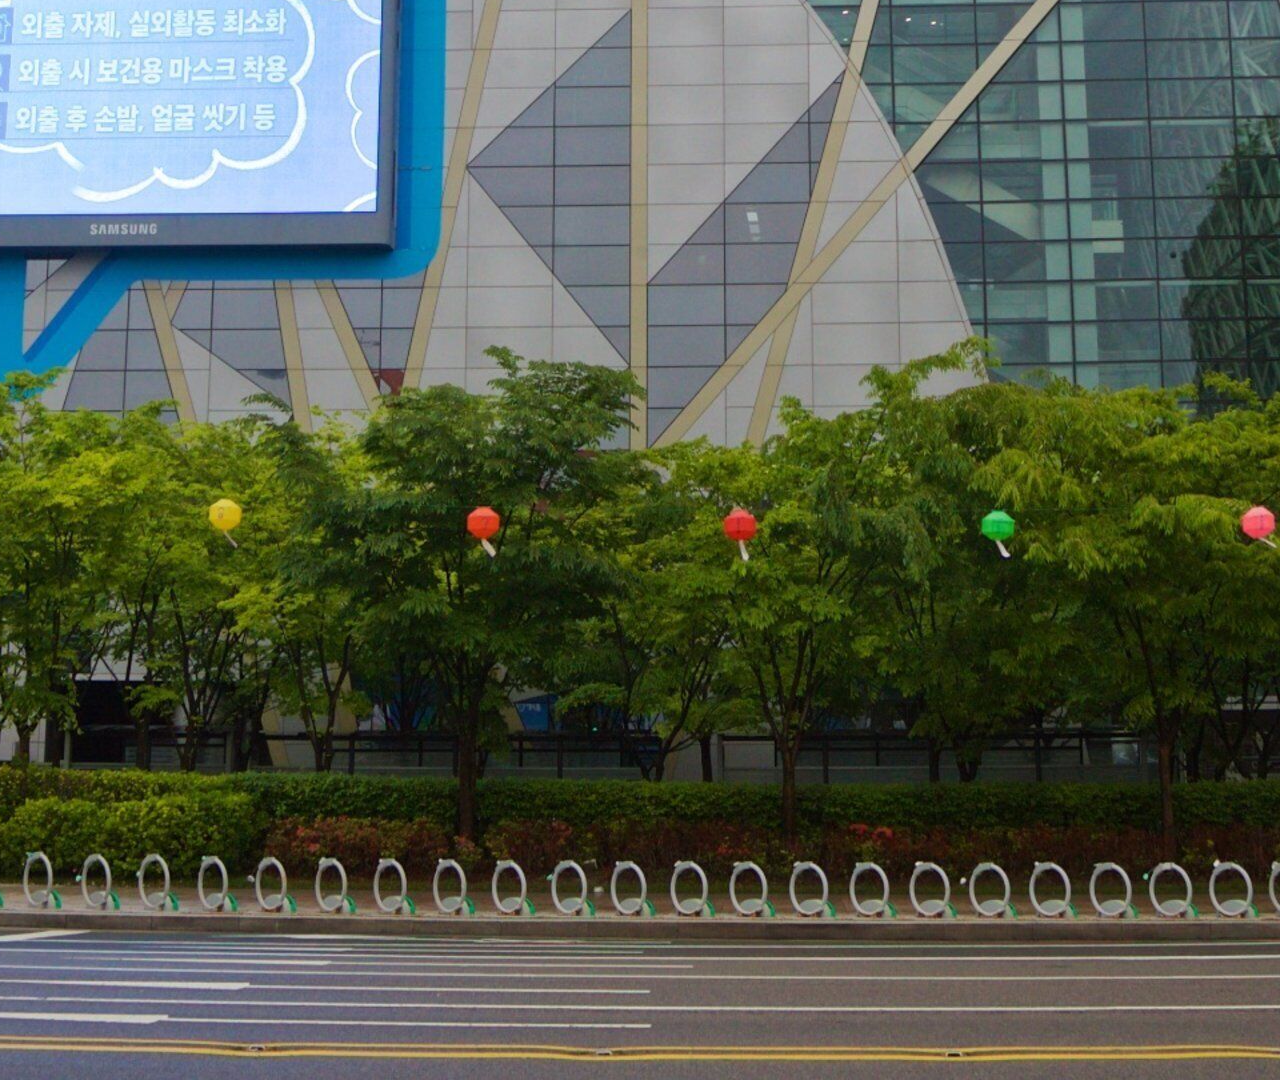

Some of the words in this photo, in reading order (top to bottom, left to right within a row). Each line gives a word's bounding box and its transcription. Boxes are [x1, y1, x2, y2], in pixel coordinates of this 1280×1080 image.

[21, 11, 65, 39] 외출
[71, 10, 122, 39] 자제,
[128, 8, 217, 38] 실외활동
[222, 8, 287, 36] 최소화
[18, 58, 63, 86] 외출
[69, 57, 90, 85] 시
[95, 56, 163, 85] 보건용
[169, 56, 238, 84] 마스크
[242, 54, 288, 83] 착용
[15, 105, 60, 134] 외출
[65, 104, 89, 134] 후
[93, 104, 145, 133] 손발,
[151, 104, 196, 133] 얼굴
[202, 103, 247, 132] 씻기
[252, 103, 276, 131] 등
[89, 223, 158, 236] SAMSUNG
